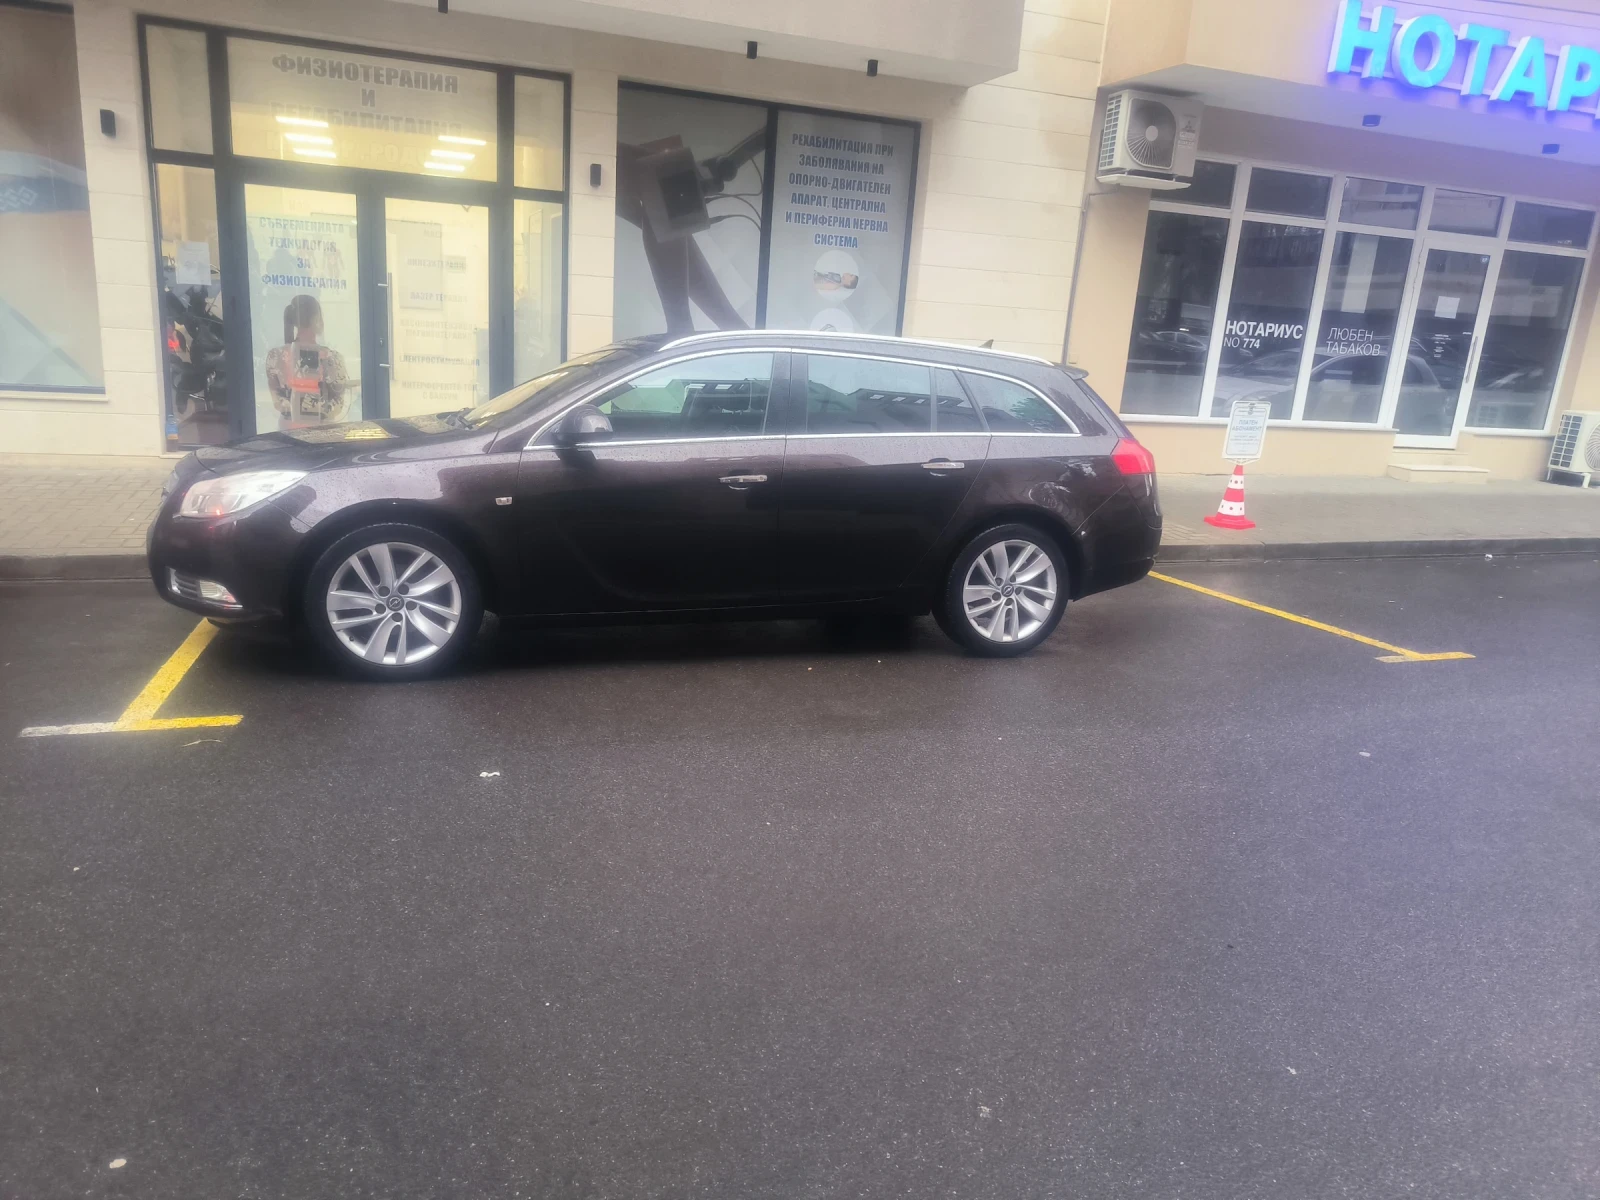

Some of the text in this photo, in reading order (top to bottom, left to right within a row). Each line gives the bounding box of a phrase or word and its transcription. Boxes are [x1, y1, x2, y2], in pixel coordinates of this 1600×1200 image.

[1327, 0, 1600, 118] НОТАР
[271, 54, 459, 94] ФИЗИОТЕРАПИЯ
[361, 88, 376, 107] И
[792, 133, 894, 156] РЕХАБИЛИТАЦИЯ ПРИ
[798, 154, 884, 175] ЗАБОЛЯВАНИЯ НА
[788, 172, 891, 195] ОПОРНО-ДВИГАТЕЛЕН
[831, 197, 886, 214] ЦЕНТРАЛНА
[785, 211, 889, 233] И ПЕРИФЕРНА НЕРВНА
[814, 233, 858, 248] СИСТЕМА
[296, 257, 311, 269] ЗА
[261, 273, 347, 290] ФИЗИОТЕРАПИЯ
[1225, 320, 1303, 340] НОТАРИУС
[1328, 327, 1374, 342] ЛЮБЕН
[1242, 338, 1260, 349] 774
[1325, 341, 1381, 356] ТАБАКОВ
